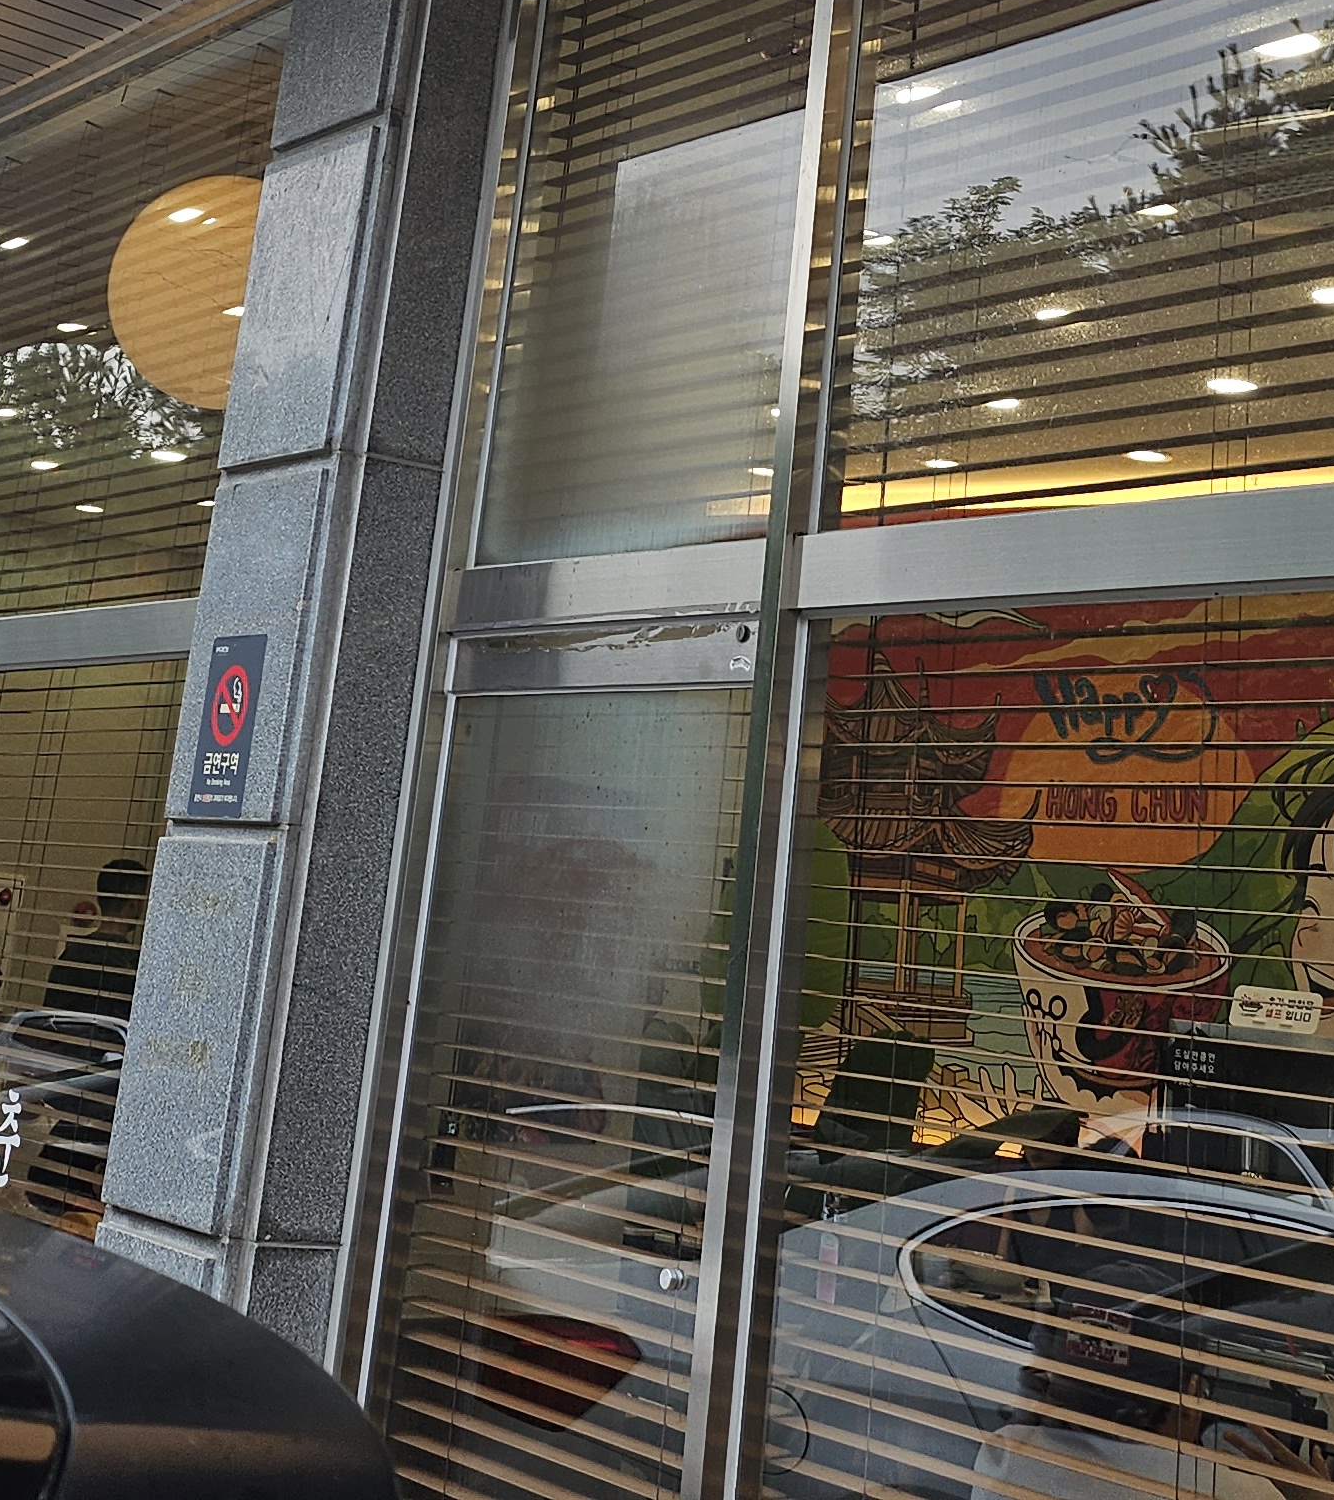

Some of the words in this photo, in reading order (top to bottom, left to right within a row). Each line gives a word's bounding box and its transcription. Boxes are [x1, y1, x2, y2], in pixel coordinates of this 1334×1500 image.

[1033, 671, 1208, 762] Happy
[203, 752, 240, 776] 금연구역
[1046, 780, 1117, 822] HONG
[1131, 781, 1208, 822] CHUN
[1265, 1009, 1283, 1019] 셀프
[1285, 1011, 1312, 1022] 입니다
